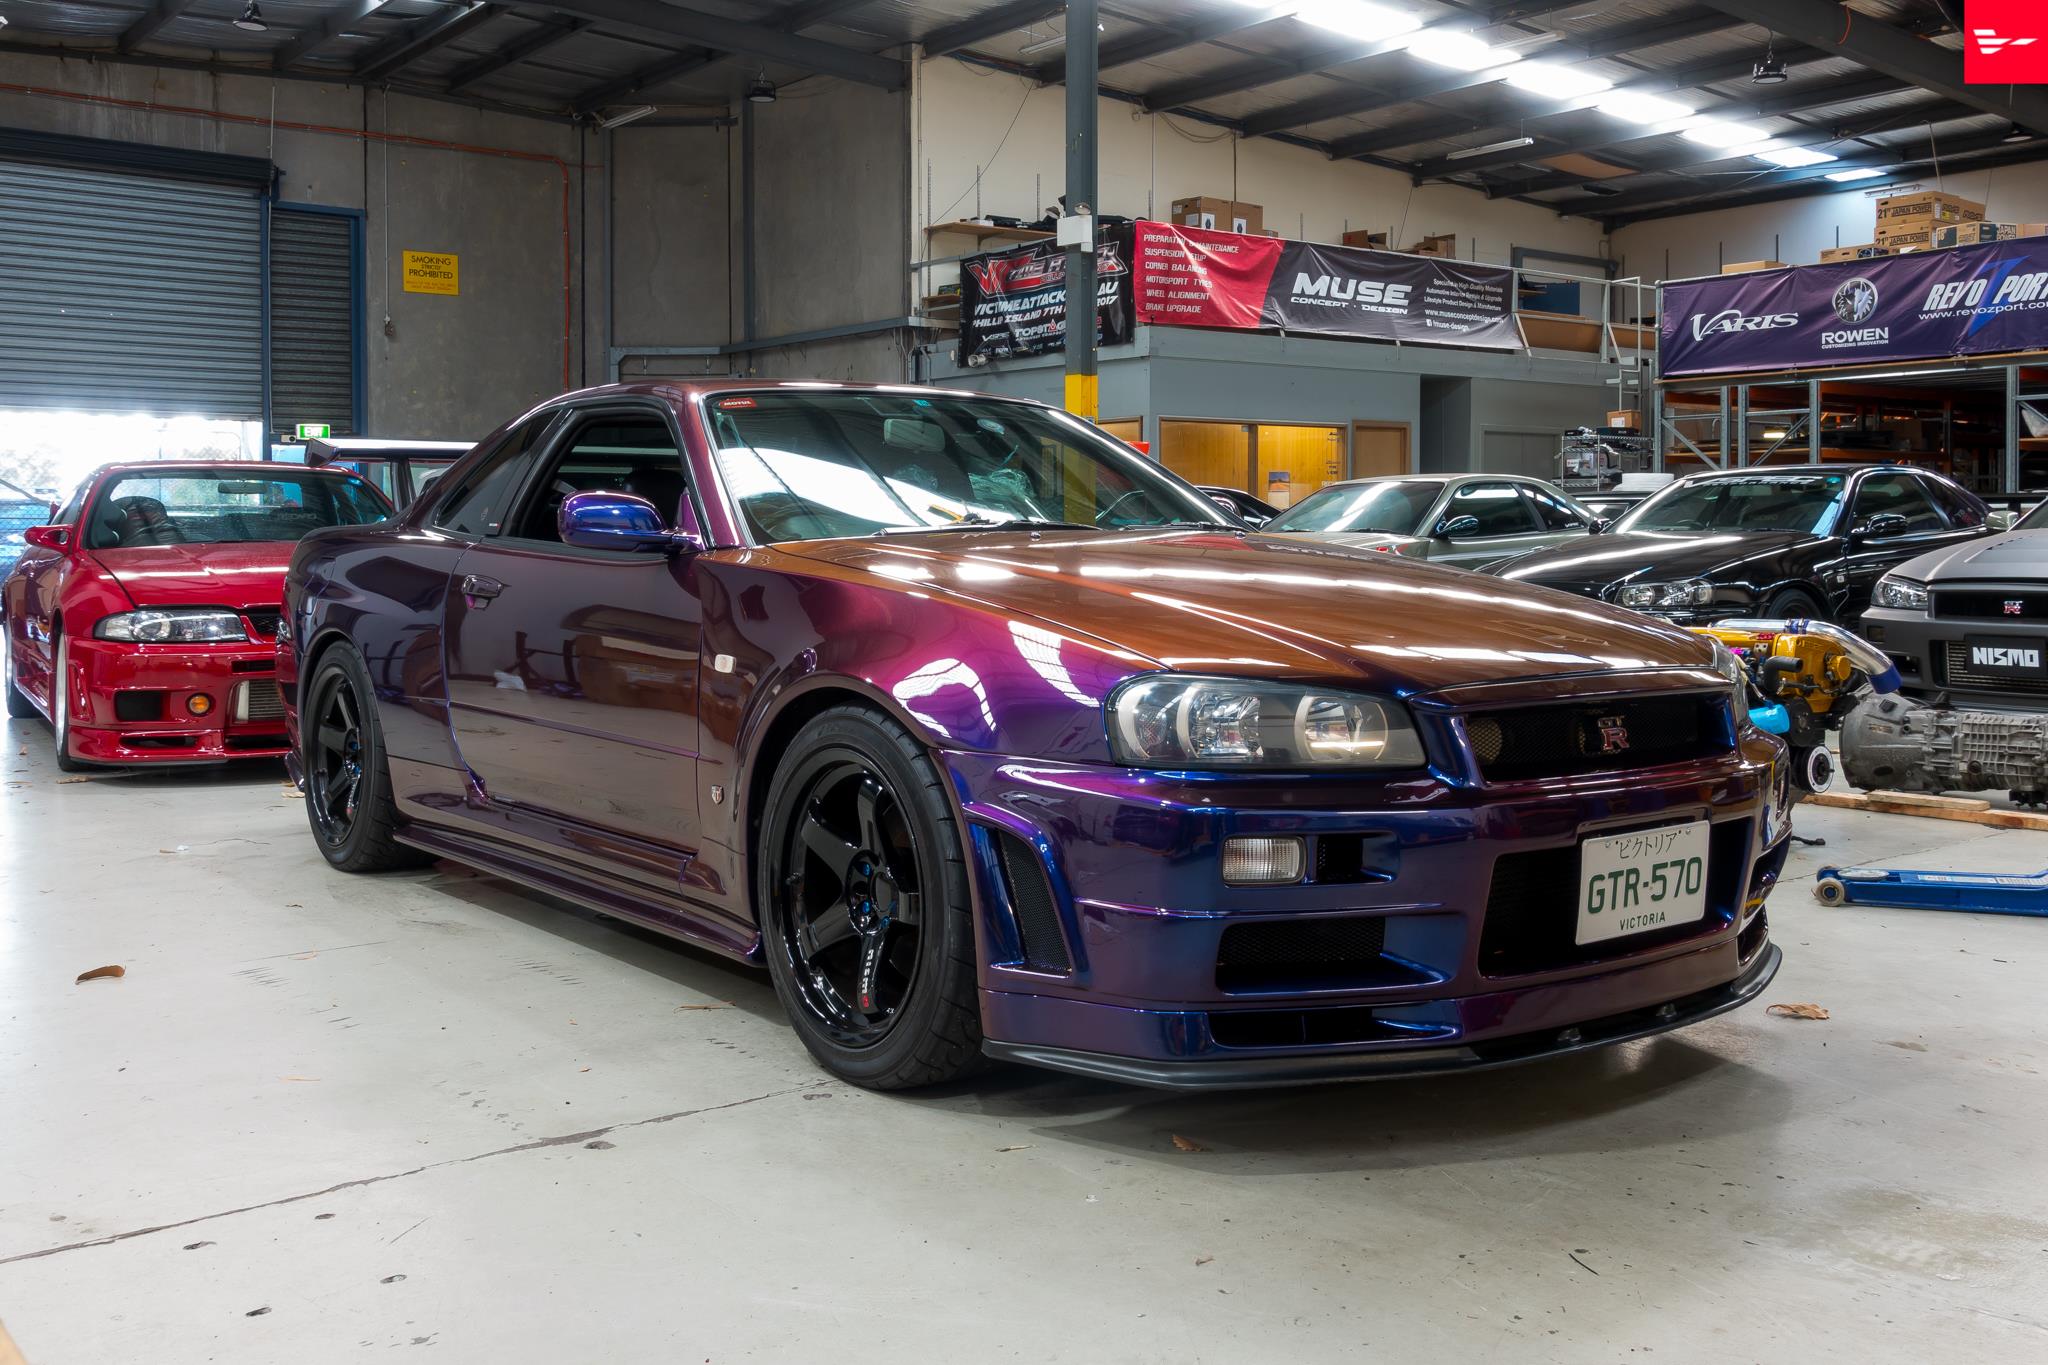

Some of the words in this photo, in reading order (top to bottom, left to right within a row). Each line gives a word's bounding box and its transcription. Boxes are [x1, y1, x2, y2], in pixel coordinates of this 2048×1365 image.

[1144, 248, 1185, 257] SUSPENSION
[411, 255, 451, 265] SMOKING
[408, 268, 453, 279] PROHIBITED
[1145, 276, 1188, 286] MOTORSPORT
[1167, 291, 1210, 300] ALIGNMENT
[1292, 272, 1413, 306] MUSE
[1166, 304, 1202, 313] UPGRADE
[1290, 296, 1349, 308] CONCEPT
[1361, 304, 1408, 315] DESIGN
[1443, 298, 1458, 307] Product
[1005, 309, 1042, 323] ISLAND
[1042, 304, 1062, 317] 7TH
[1690, 309, 1799, 342] VARIS
[1821, 327, 1889, 345] ROWEN
[1972, 647, 2040, 668] NISMO
[1619, 911, 1666, 931] VICTORIA
